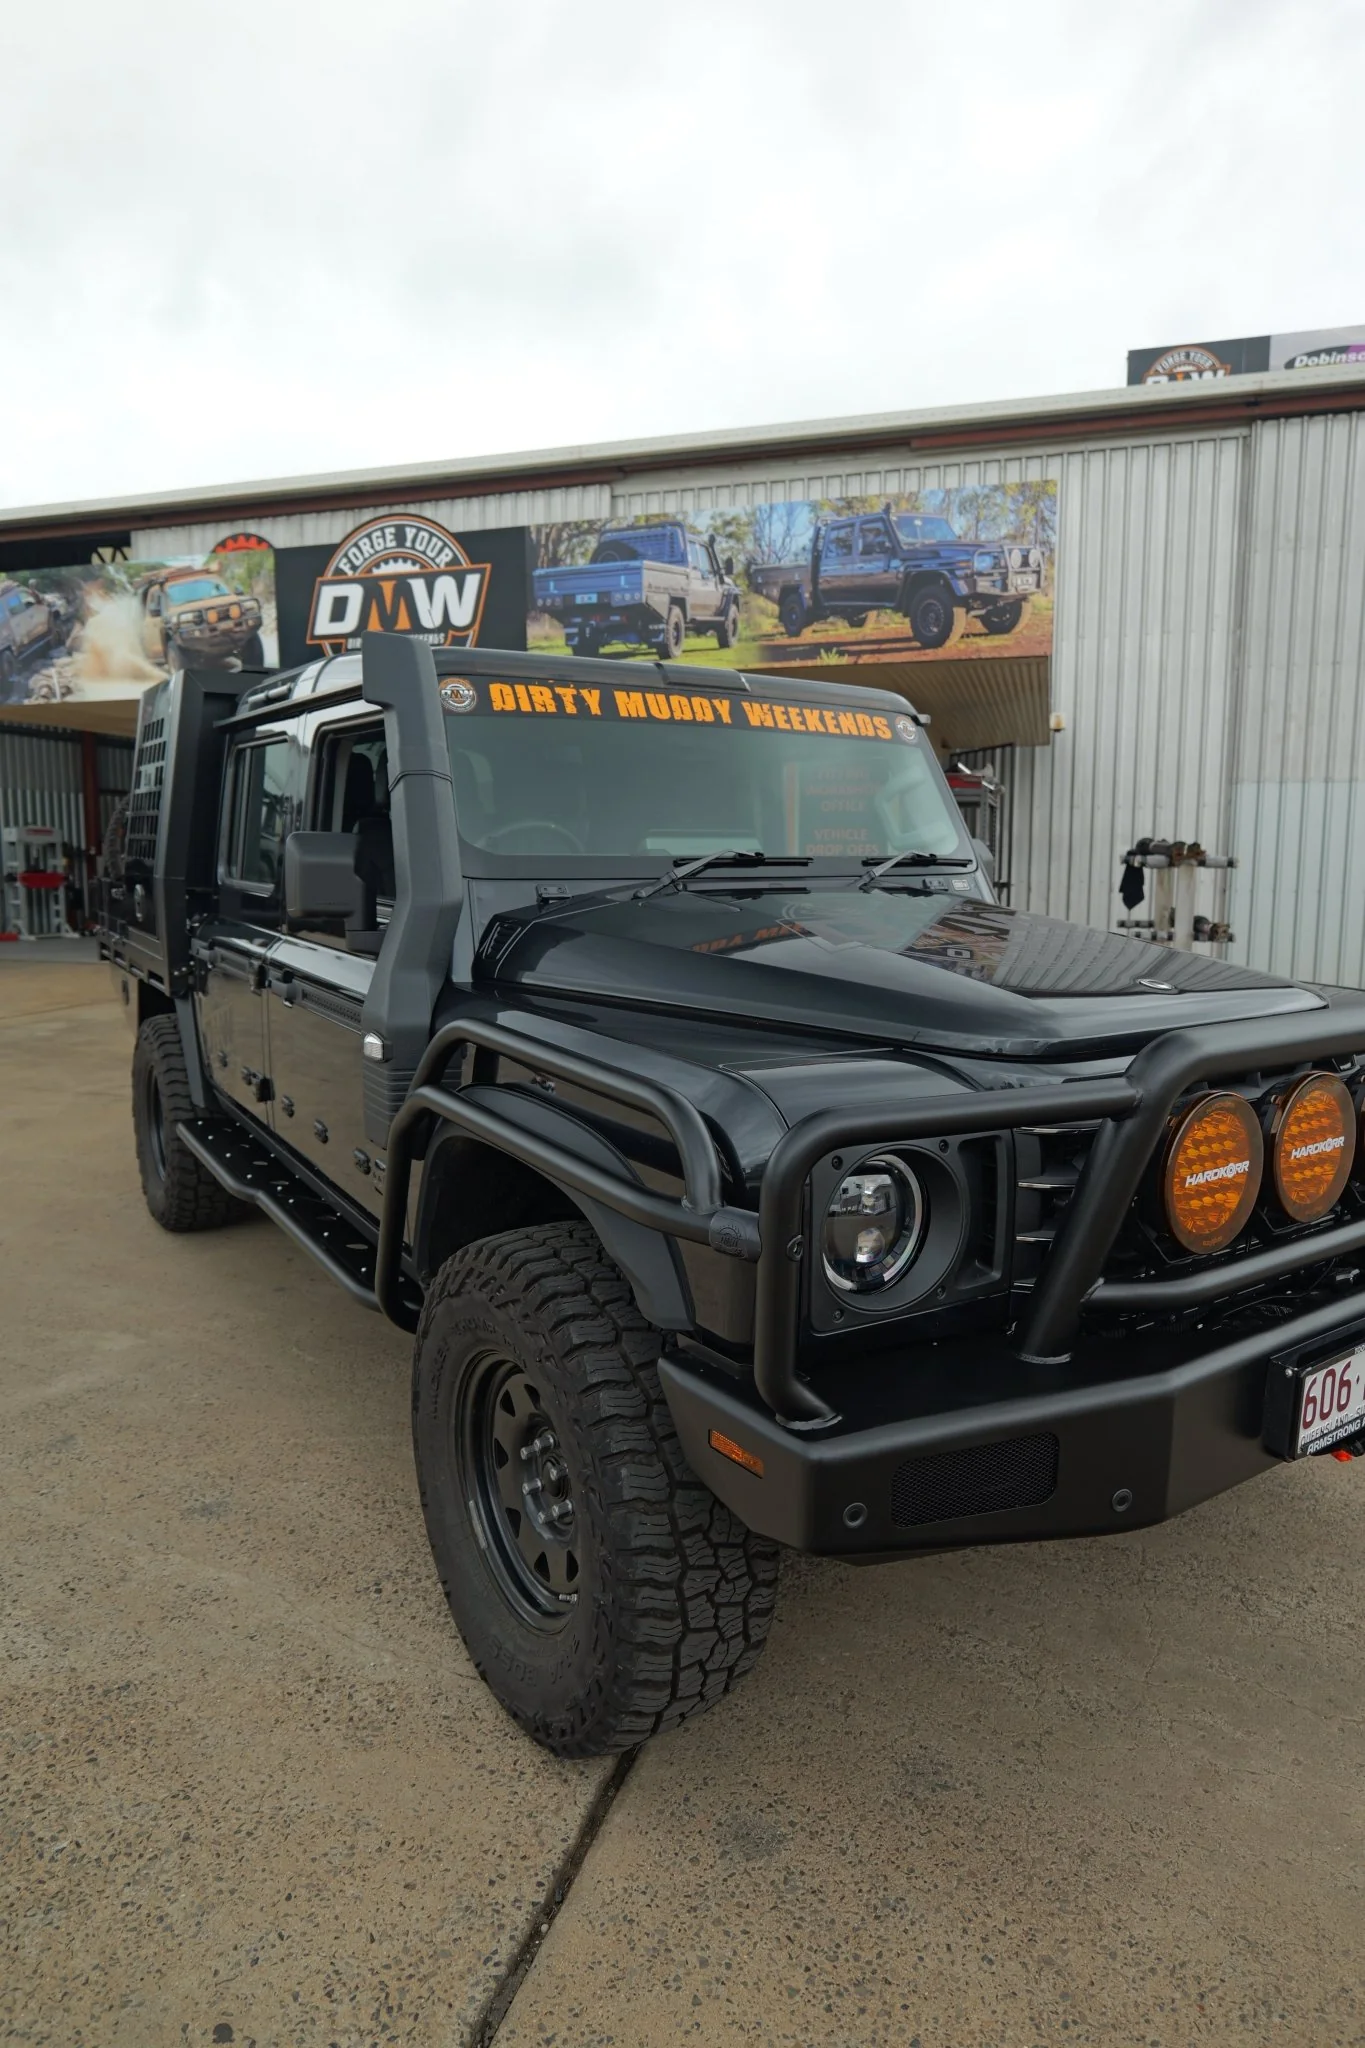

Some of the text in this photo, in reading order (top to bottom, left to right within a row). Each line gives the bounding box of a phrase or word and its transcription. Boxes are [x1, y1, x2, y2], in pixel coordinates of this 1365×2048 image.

[338, 527, 454, 576] FORGE YOUR
[313, 573, 481, 636] DMW
[489, 683, 602, 715] DIRTY
[613, 689, 732, 723] MUDDY
[741, 701, 893, 740] WEEKENDS
[806, 844, 843, 856] DROP
[814, 829, 869, 841] VEHICLE
[1291, 1136, 1345, 1160] HARDKORR
[1185, 1160, 1249, 1188] HARDKORR
[1307, 1419, 1361, 1456] ARMSTRONG
